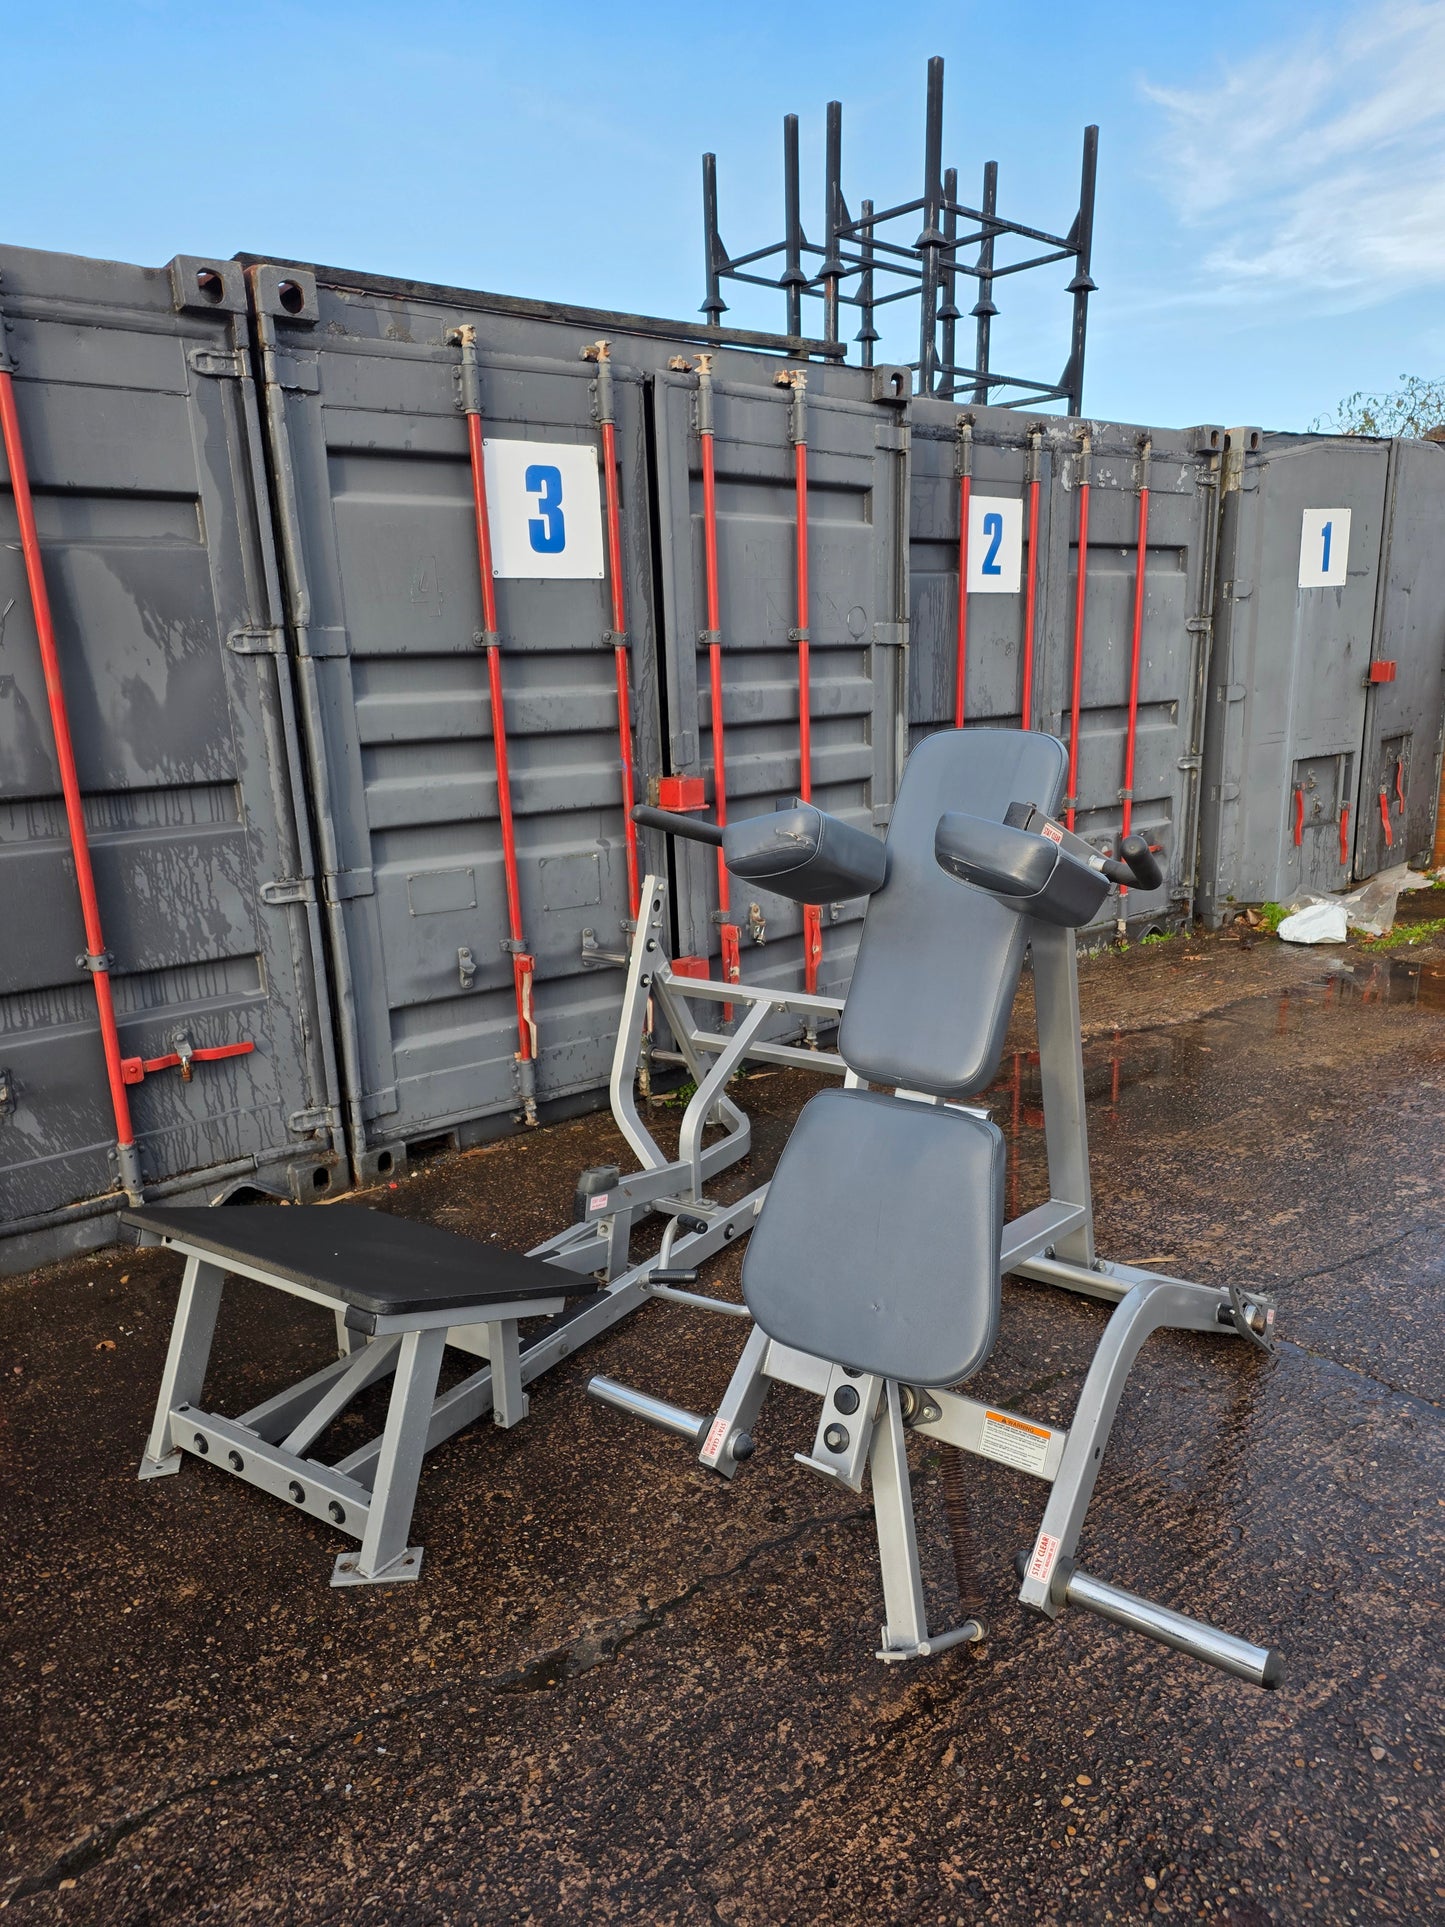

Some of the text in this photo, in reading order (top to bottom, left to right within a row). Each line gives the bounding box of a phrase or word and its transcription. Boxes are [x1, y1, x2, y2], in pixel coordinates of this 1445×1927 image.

[525, 464, 566, 554] 3
[982, 512, 1004, 576] 2
[1321, 521, 1332, 572] 1
[717, 1422, 727, 1437] STAY
[1008, 1420, 1035, 1433] WARNING
[1031, 1536, 1049, 1576] STAY CLEAR
